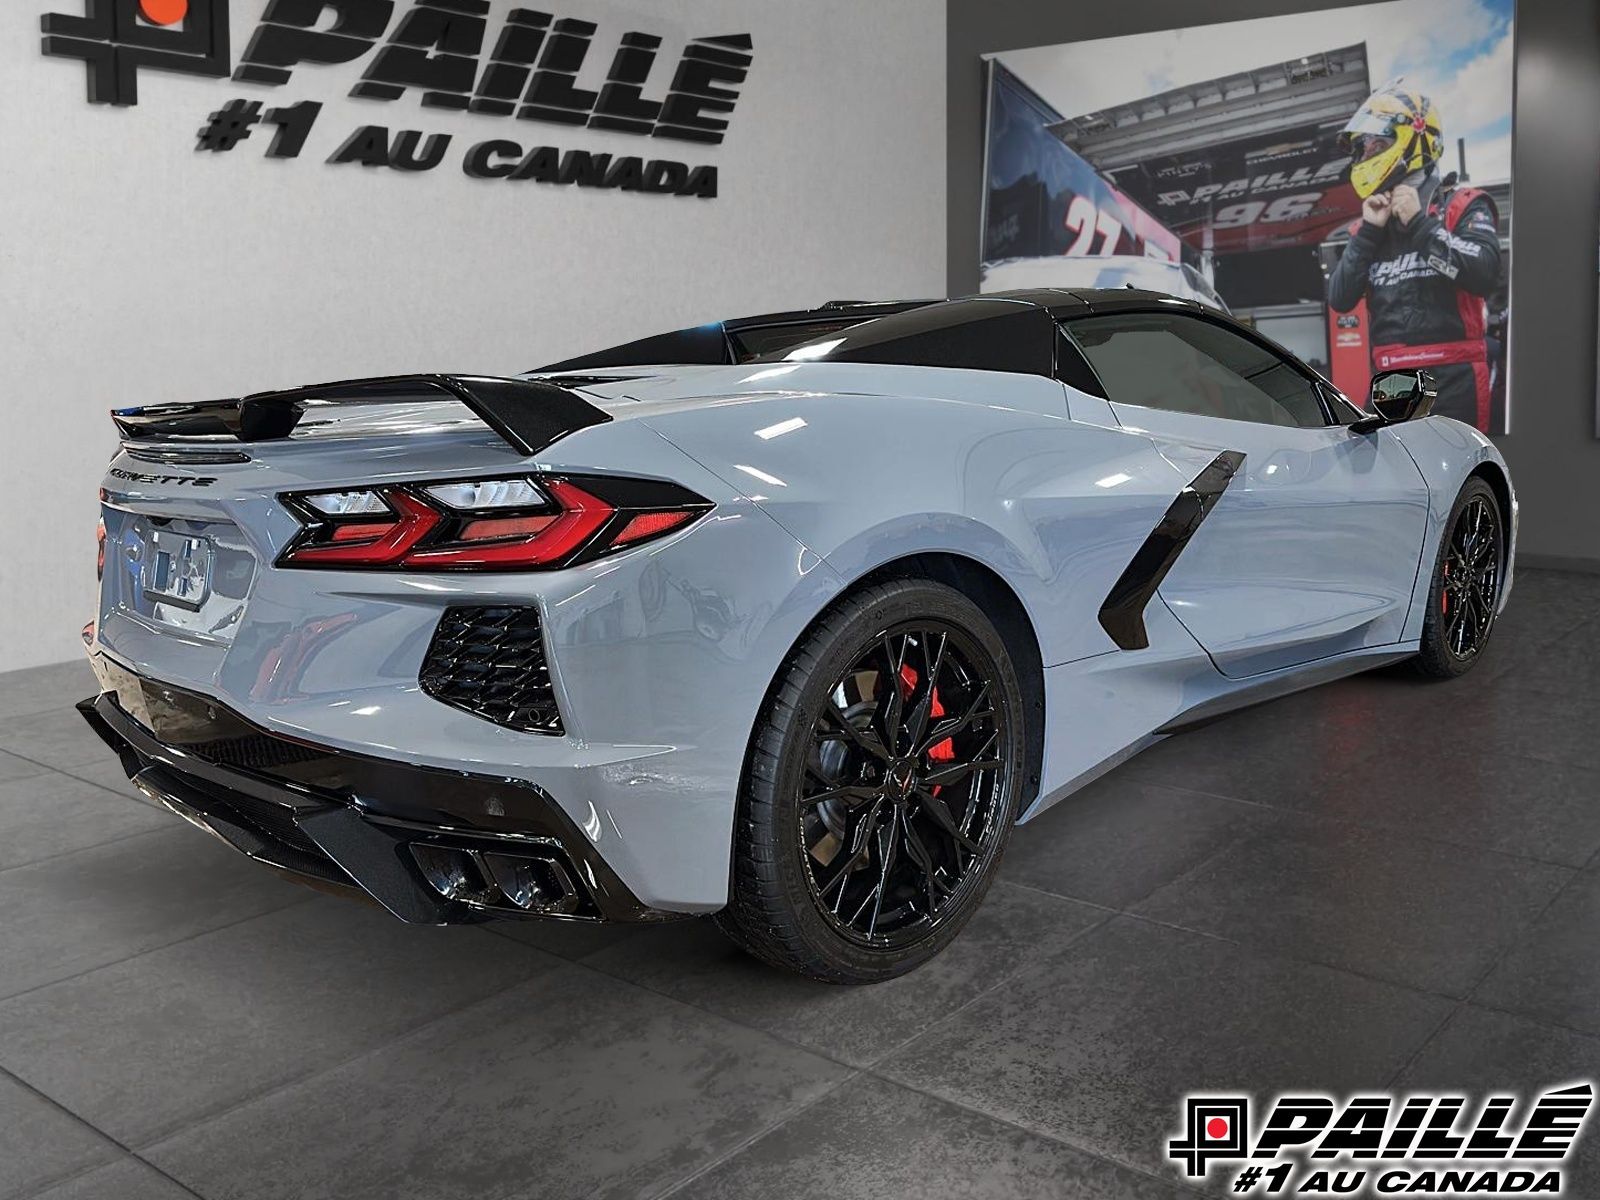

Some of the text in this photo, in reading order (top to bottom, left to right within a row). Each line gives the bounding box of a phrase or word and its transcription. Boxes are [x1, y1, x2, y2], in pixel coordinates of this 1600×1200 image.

[231, 0, 753, 145] PAILLÉ
[194, 98, 718, 198] #1 AU CANADA
[1212, 193, 1322, 229] 96
